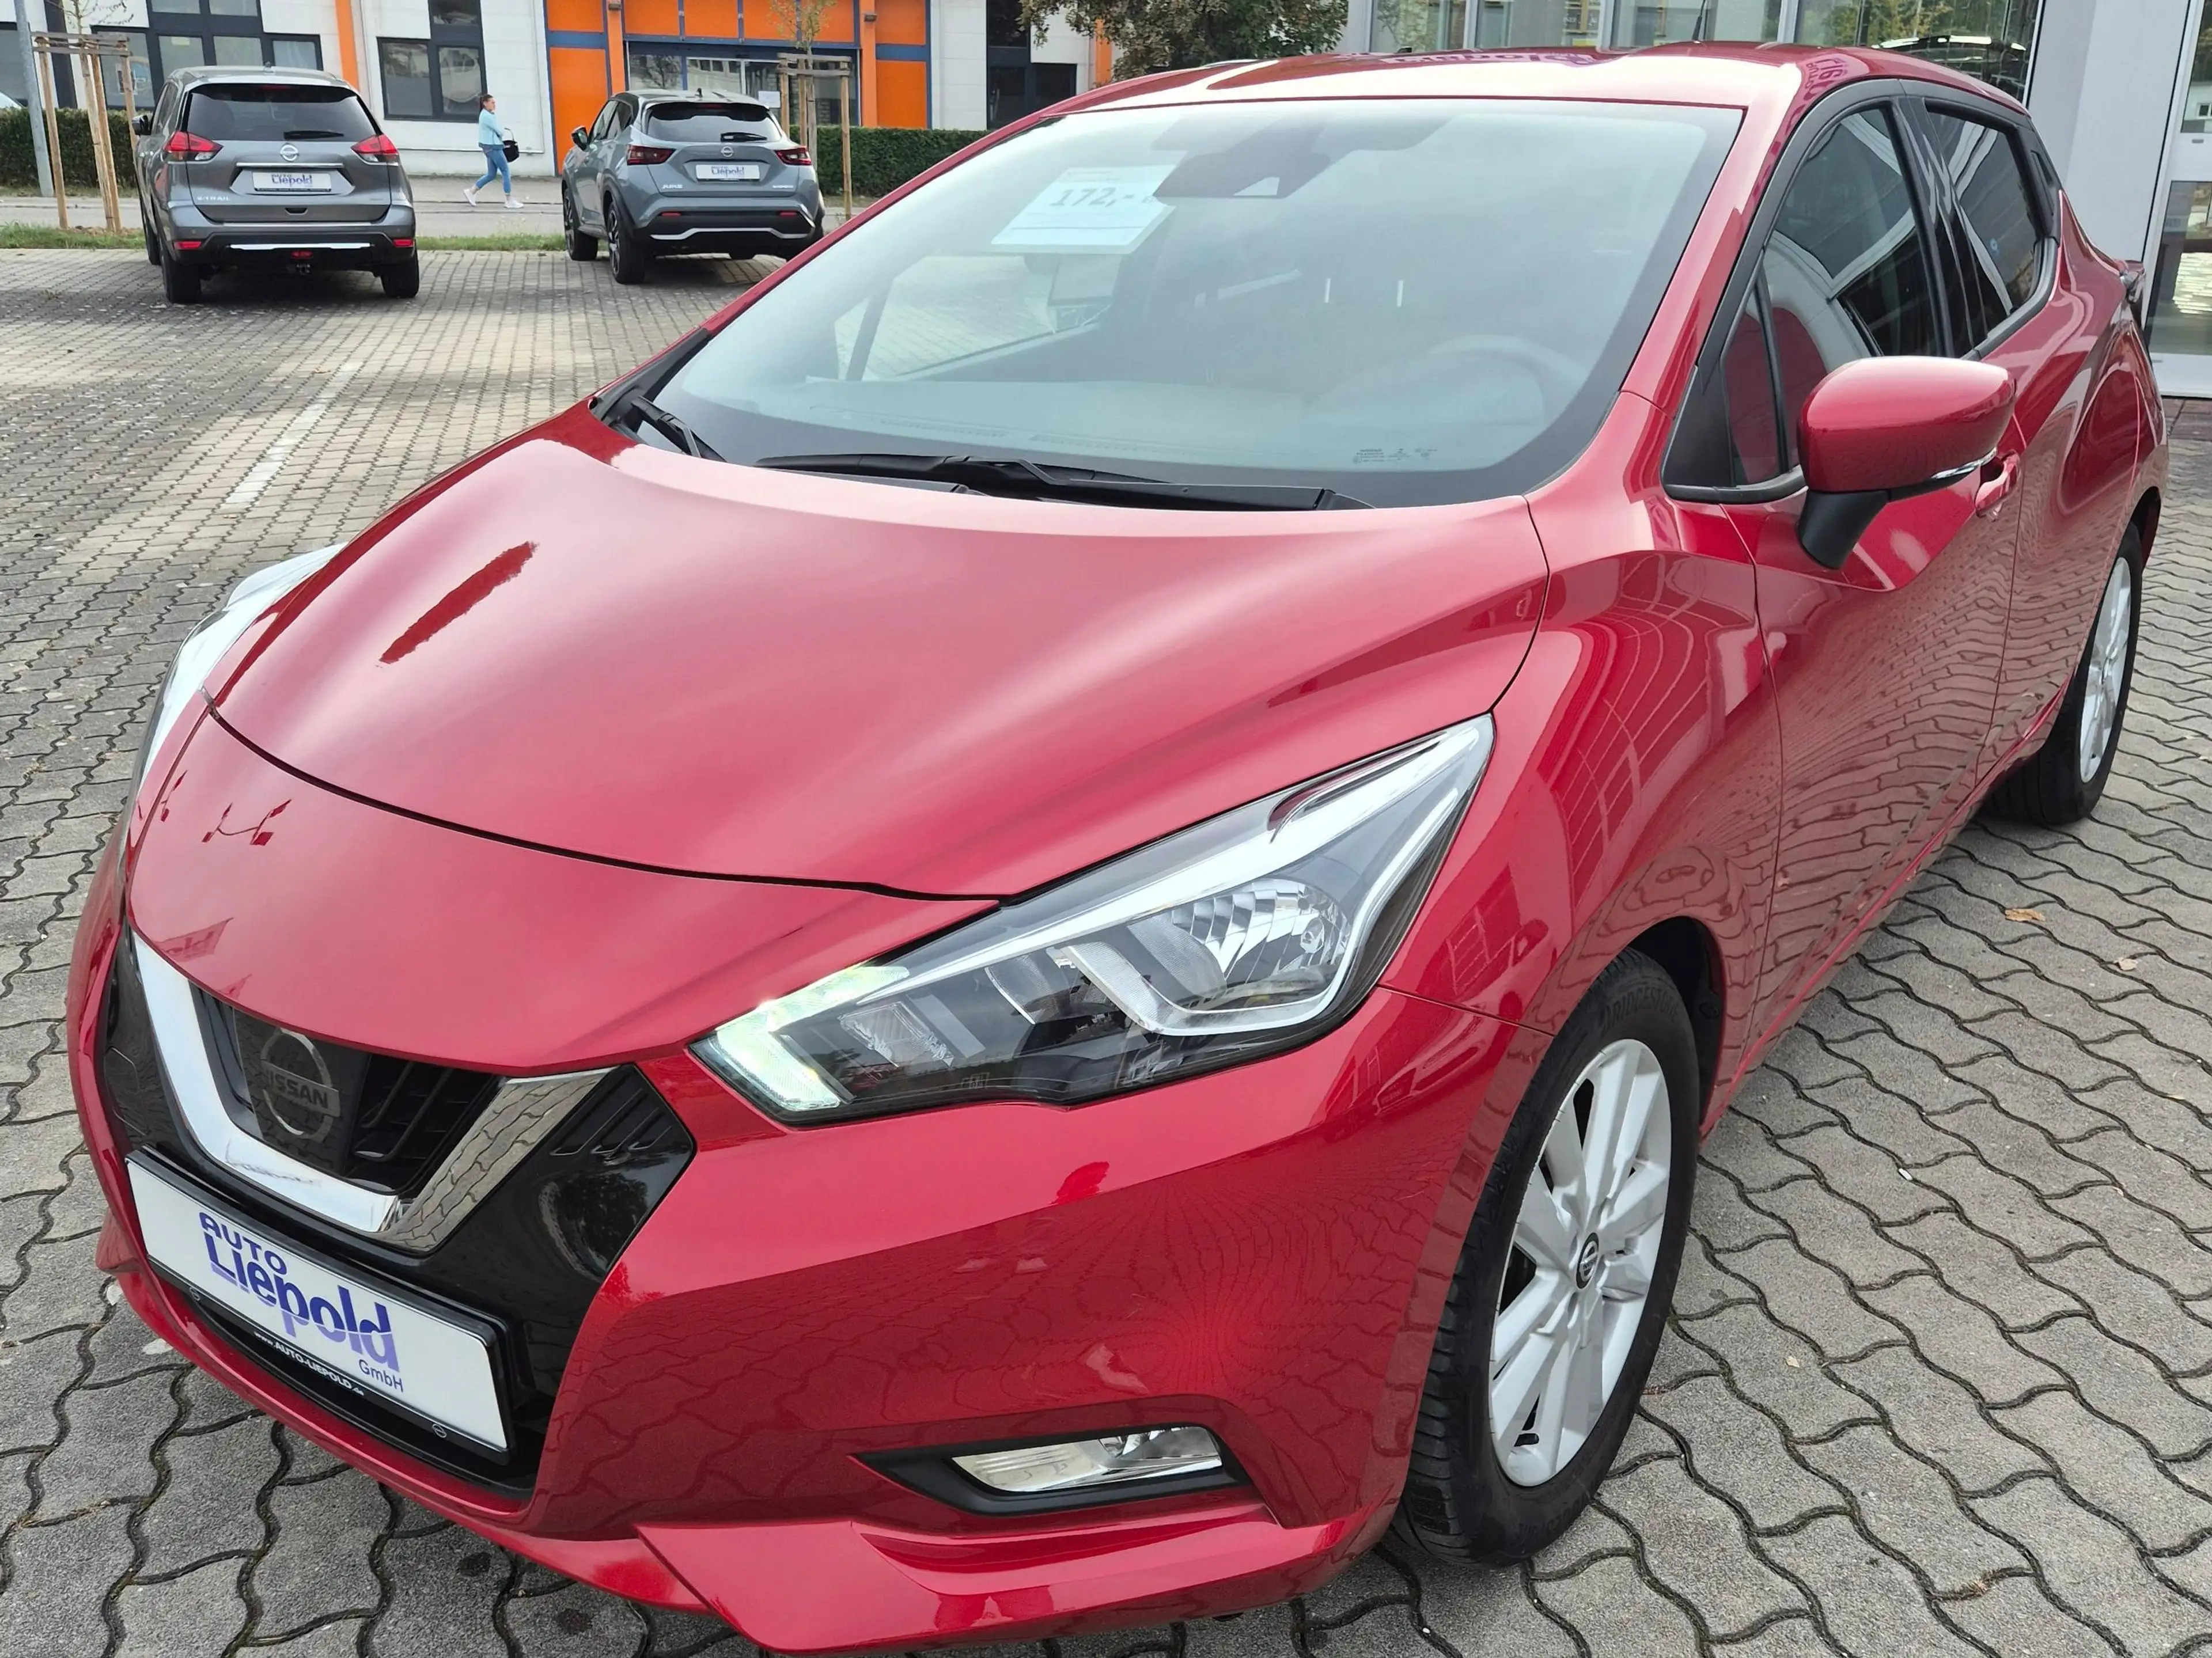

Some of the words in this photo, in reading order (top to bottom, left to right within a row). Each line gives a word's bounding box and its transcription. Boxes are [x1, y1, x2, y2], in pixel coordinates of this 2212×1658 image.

[199, 1212, 287, 1276] AUTO
[204, 1231, 400, 1373] Liepold
[358, 1359, 404, 1393] GmbH
